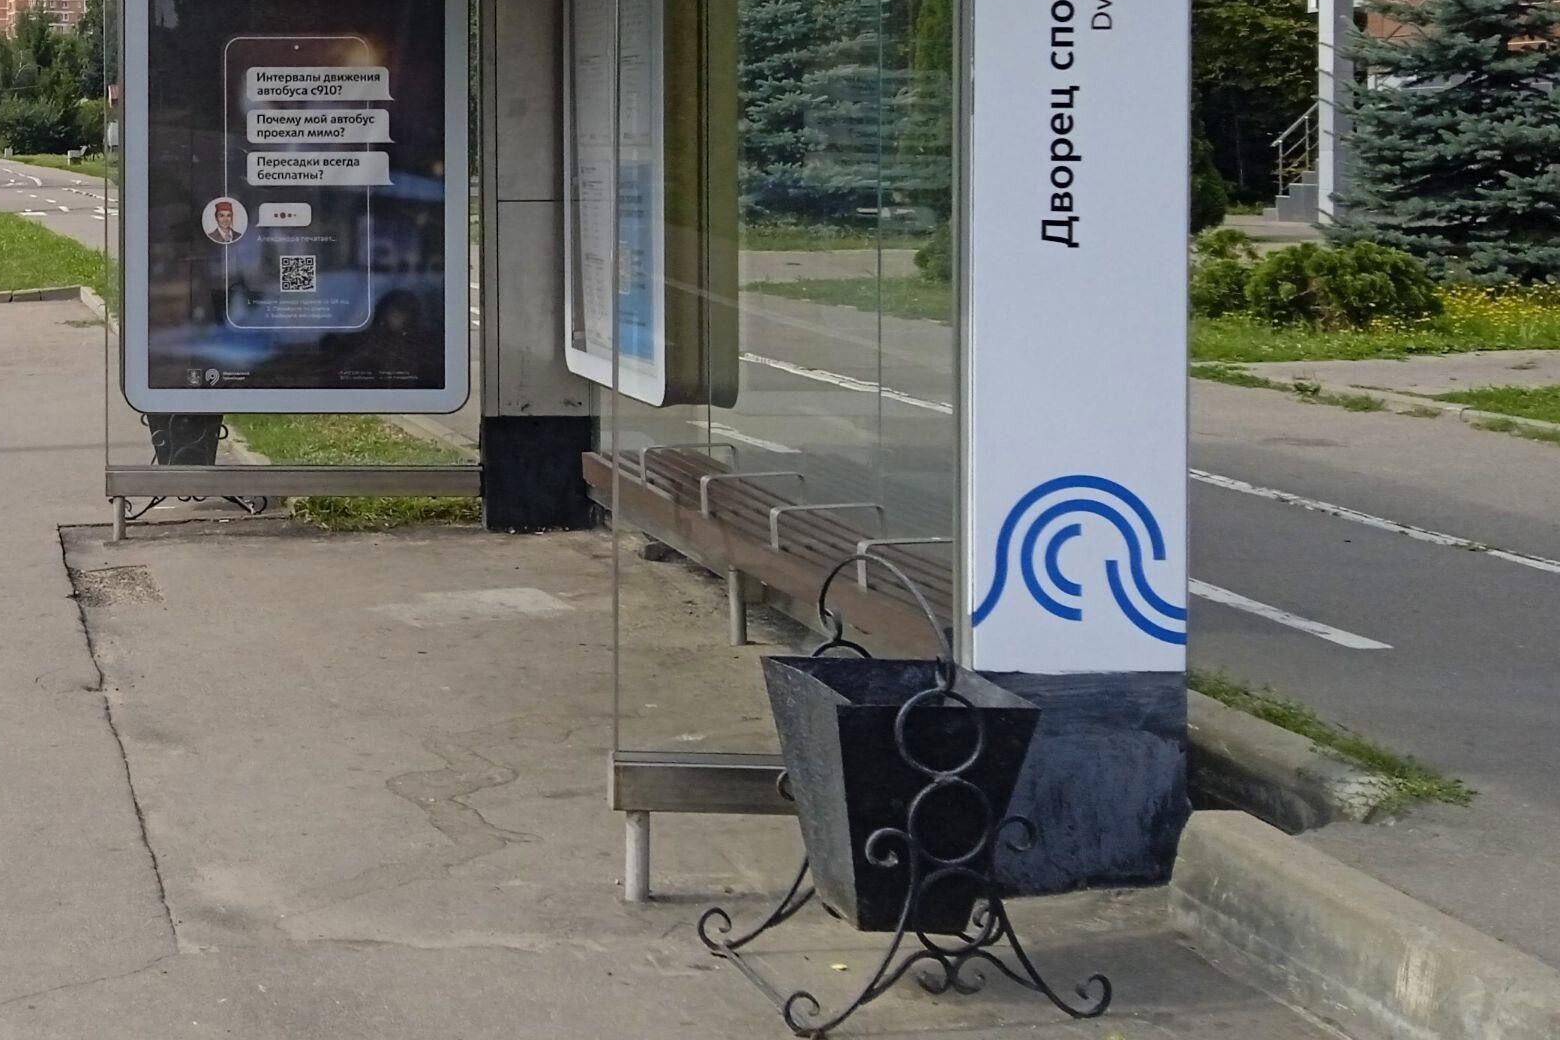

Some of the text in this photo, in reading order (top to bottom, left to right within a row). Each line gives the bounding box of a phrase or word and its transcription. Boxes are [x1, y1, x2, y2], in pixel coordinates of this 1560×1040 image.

[256, 72, 381, 84] Интервалы движения
[257, 84, 343, 98] автобуса с910?
[256, 113, 375, 127] Почему мой автобус
[256, 126, 345, 139] проехал мимо?
[256, 156, 360, 168] Пересадки всегда
[1041, 85, 1083, 249] Дворец
[257, 169, 324, 180] бесплатны?
